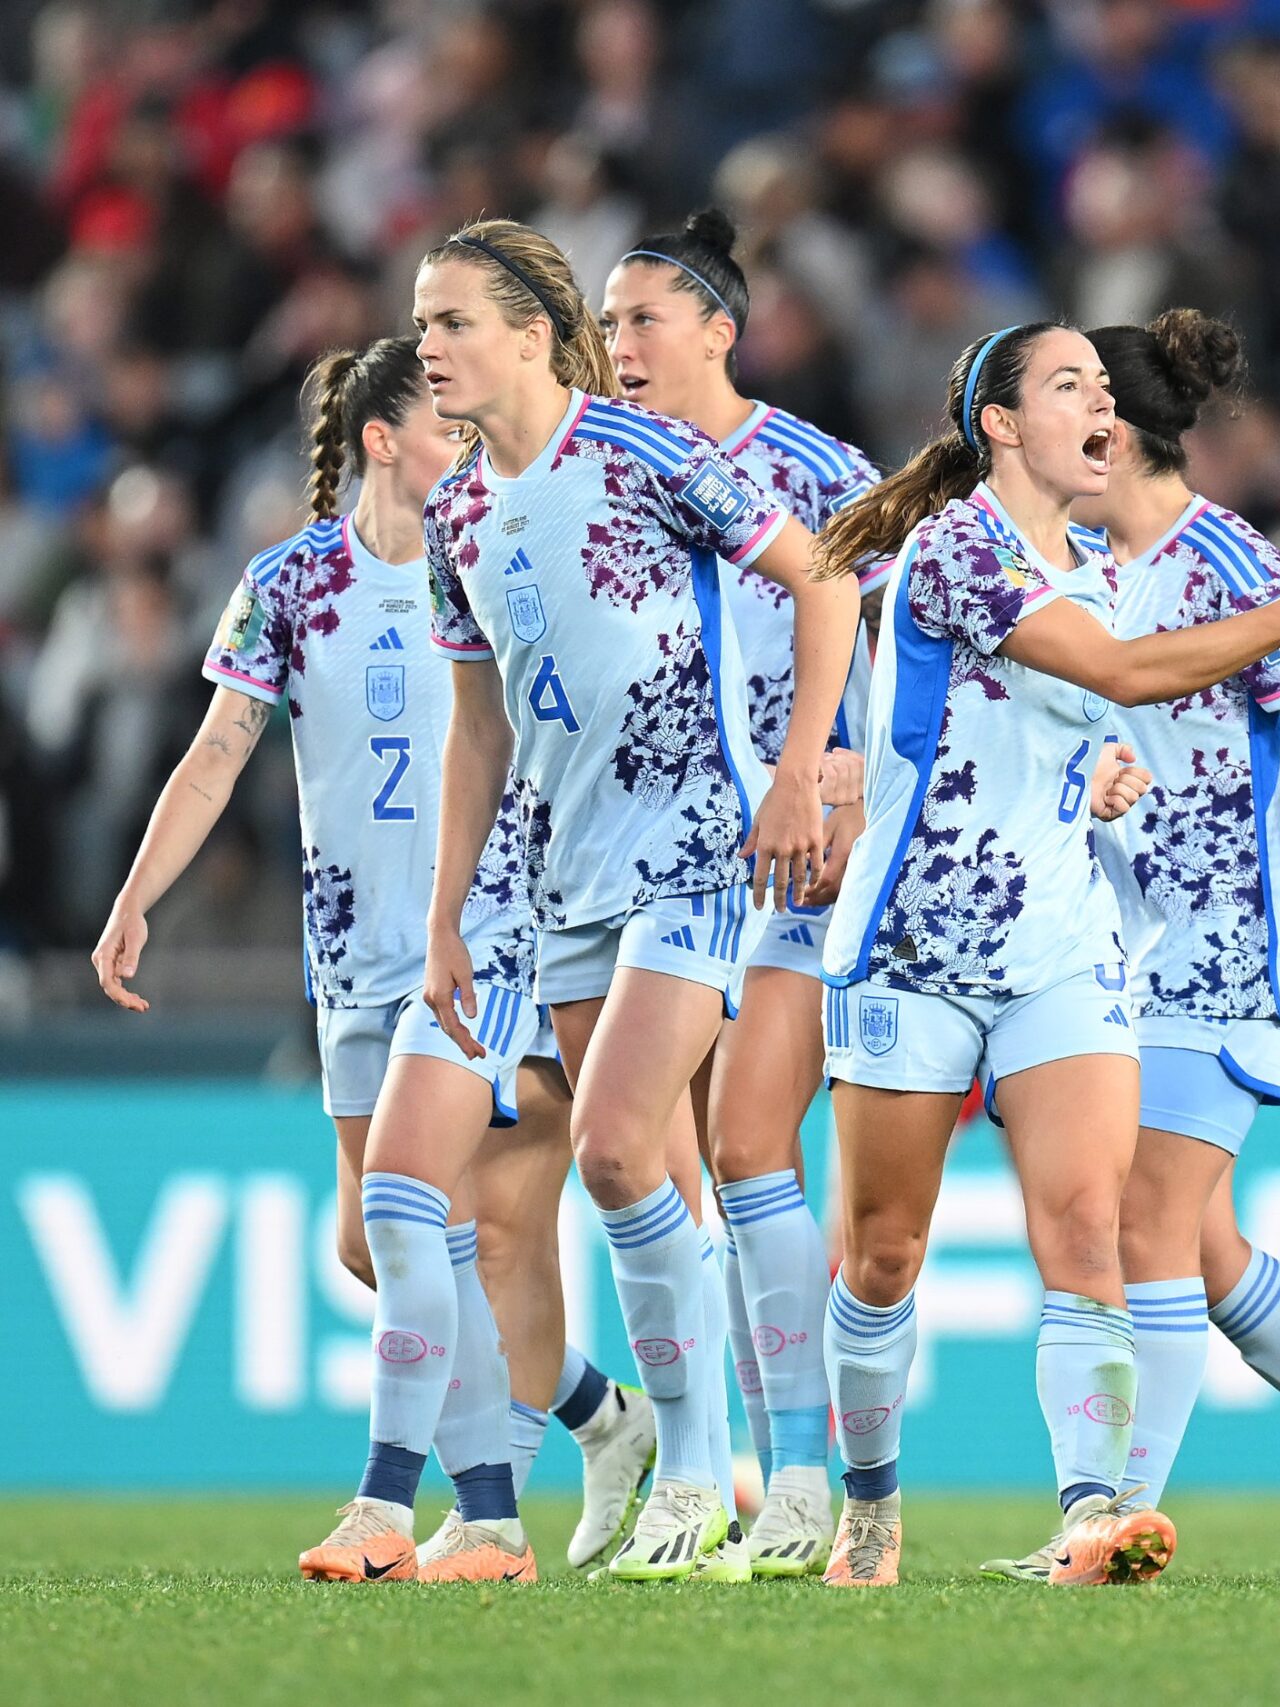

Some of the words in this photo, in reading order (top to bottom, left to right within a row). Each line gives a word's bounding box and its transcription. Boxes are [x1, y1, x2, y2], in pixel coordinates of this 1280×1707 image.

[528, 654, 582, 735] 4
[369, 735, 417, 822] 2
[1057, 737, 1091, 824] 6
[430, 1345, 446, 1357] 09
[1130, 1447, 1147, 1458] 09
